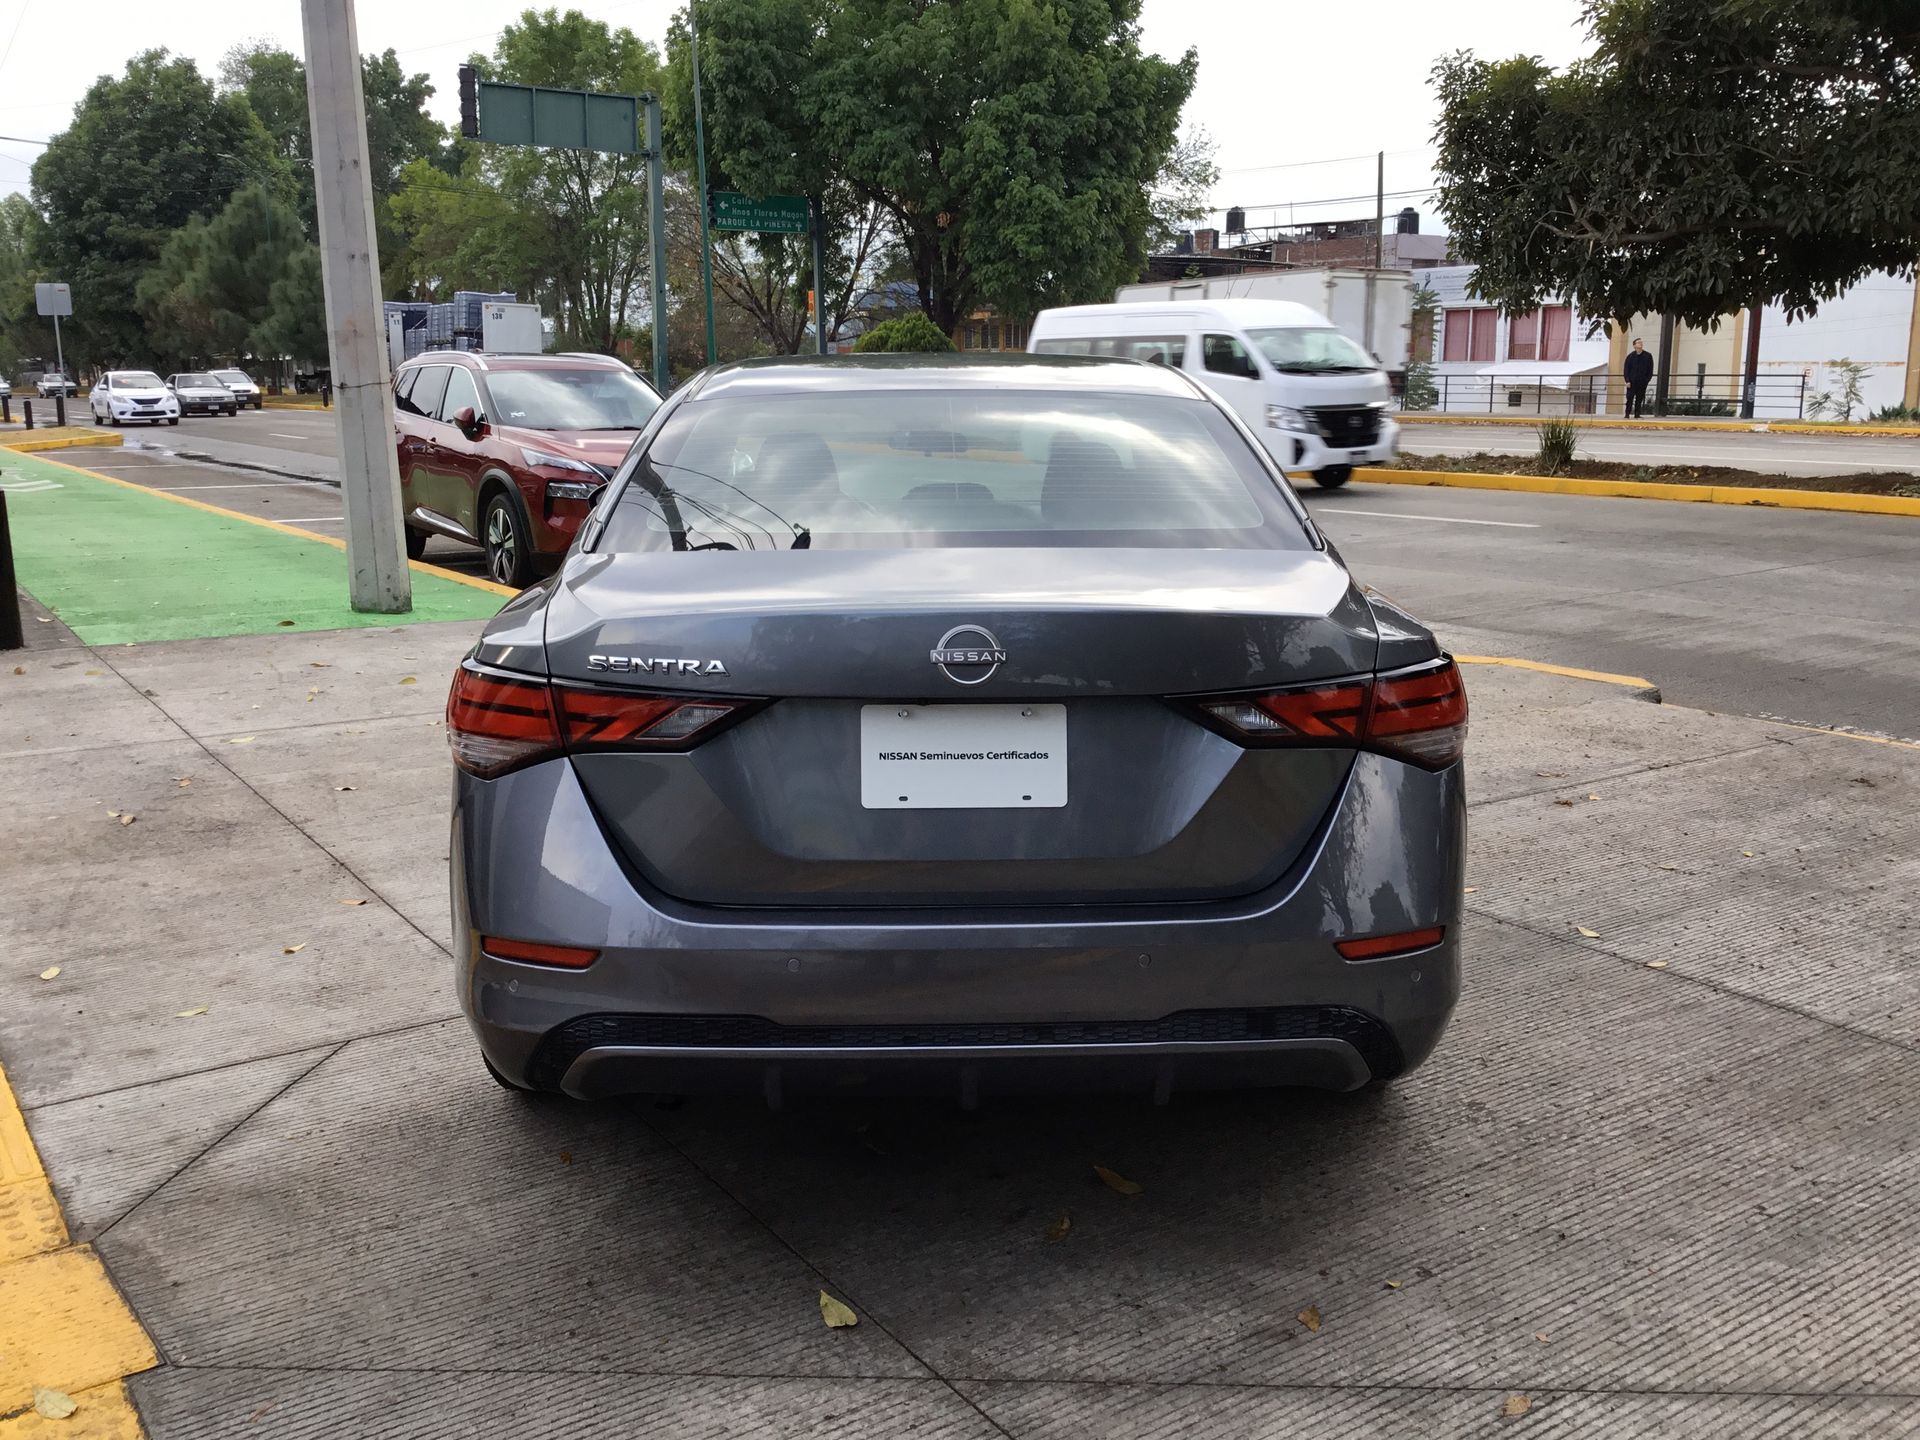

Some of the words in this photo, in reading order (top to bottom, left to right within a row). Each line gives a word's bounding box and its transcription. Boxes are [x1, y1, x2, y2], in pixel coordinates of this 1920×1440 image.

[732, 197, 753, 205] Calle
[732, 207, 751, 216] Hnos
[754, 209, 778, 217] Flores
[717, 217, 747, 226] PARQUE
[750, 219, 760, 227] LA
[932, 651, 1006, 662] NISSAN
[586, 654, 731, 677] SENTRA
[879, 751, 918, 761] NISSAN
[920, 751, 985, 761] Seminuevos
[986, 750, 1049, 761] Certificados
